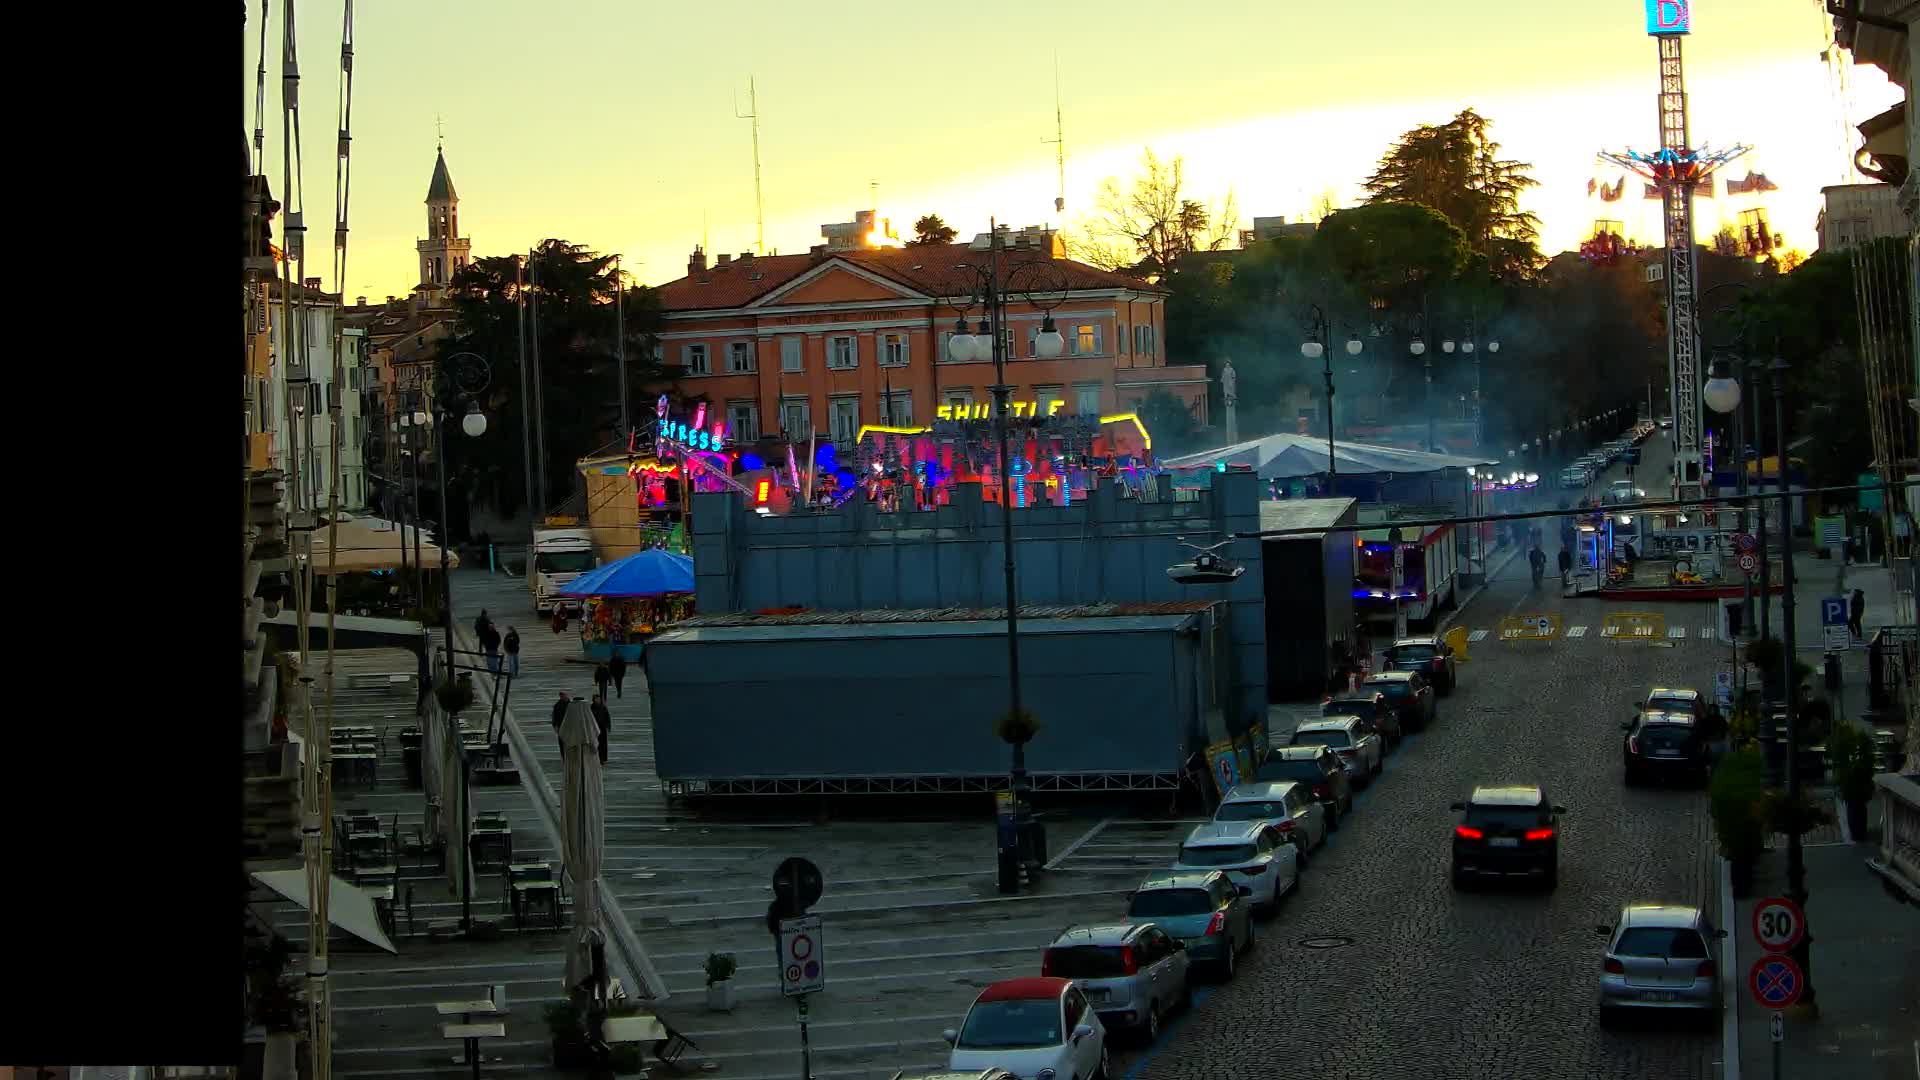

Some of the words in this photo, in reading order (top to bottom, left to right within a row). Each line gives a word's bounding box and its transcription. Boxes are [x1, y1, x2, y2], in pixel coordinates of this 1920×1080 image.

[1742, 557, 1752, 567] 20
[1826, 602, 1841, 622] P
[1762, 912, 1791, 938] 30
